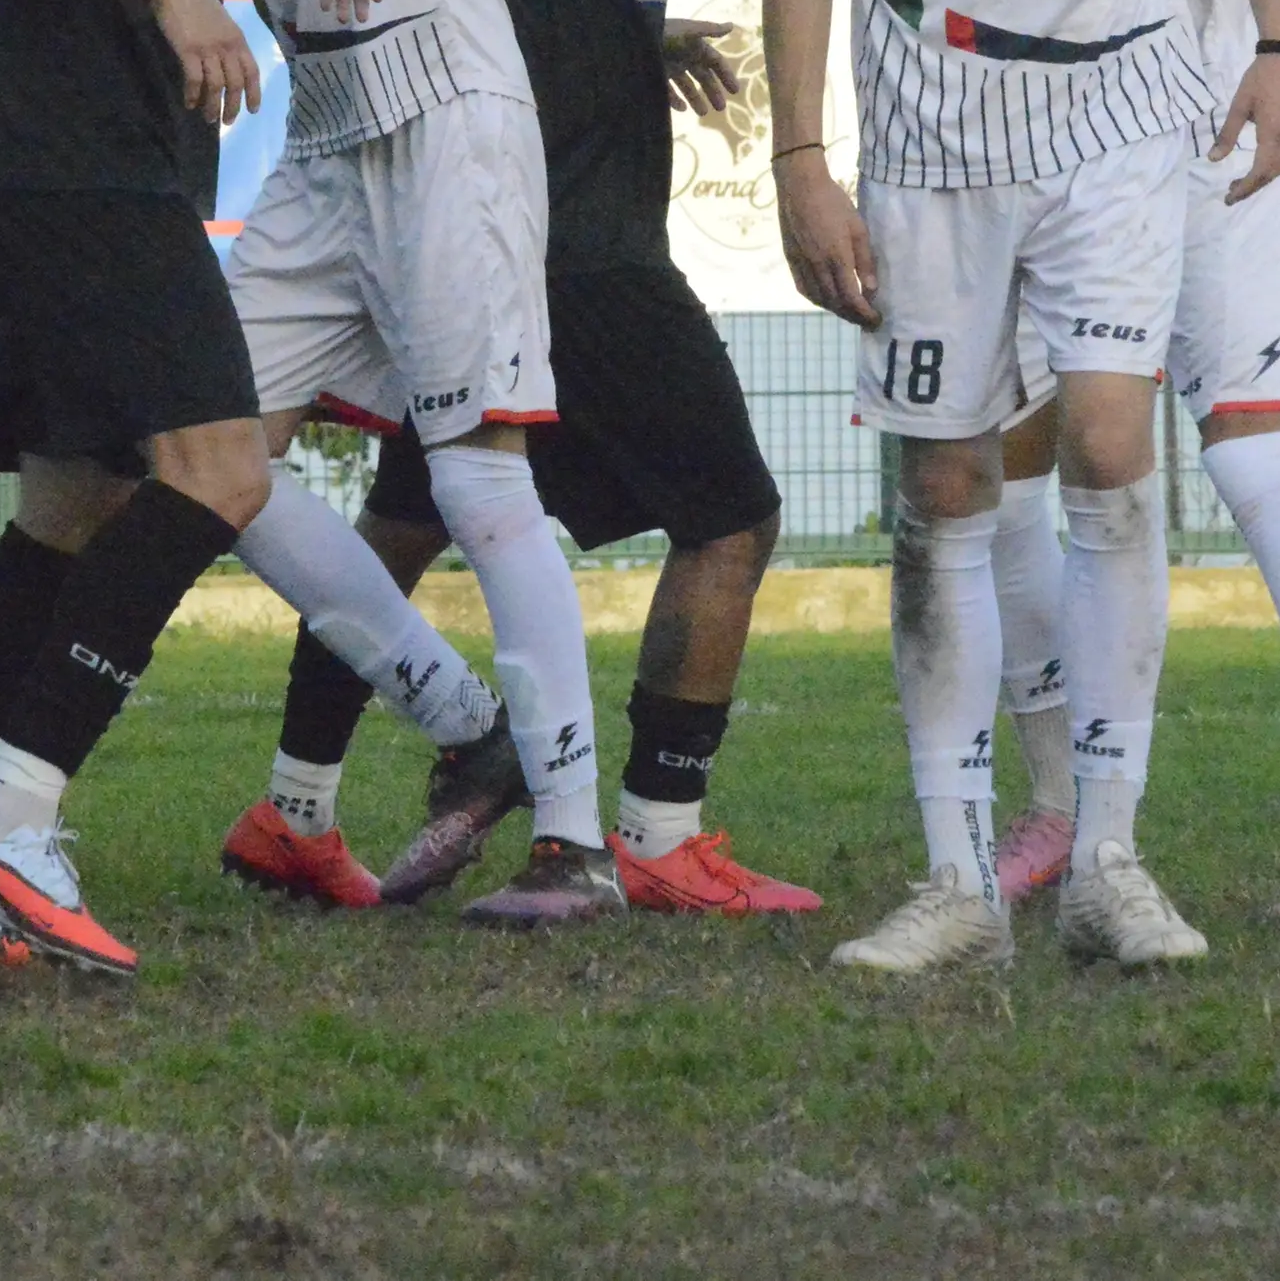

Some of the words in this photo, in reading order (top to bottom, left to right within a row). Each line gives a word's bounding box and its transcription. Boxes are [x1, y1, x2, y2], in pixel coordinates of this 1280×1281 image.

[1071, 317, 1147, 343] Zeus
[883, 338, 944, 406] 18
[544, 743, 592, 773] ZEUS
[959, 757, 993, 769] ZEU
